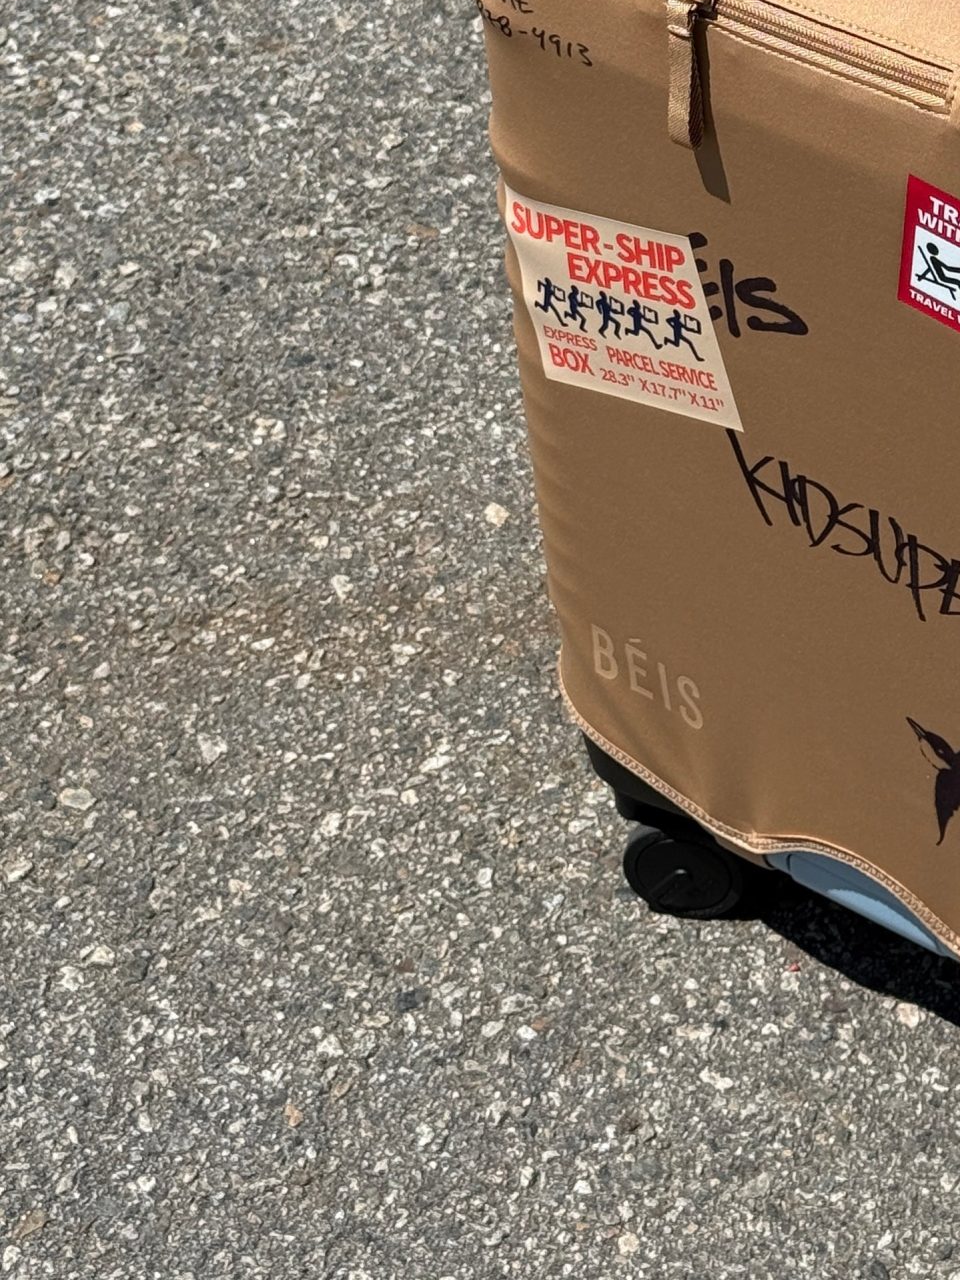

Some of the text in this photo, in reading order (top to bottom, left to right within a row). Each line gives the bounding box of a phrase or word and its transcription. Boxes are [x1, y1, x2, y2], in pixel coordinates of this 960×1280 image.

[567, 253, 696, 310] EXPRESS
[909, 289, 955, 321] TRAVEL
[543, 325, 718, 391] EXPRESS PARCEL SERVICE
[549, 343, 595, 376] BOX
